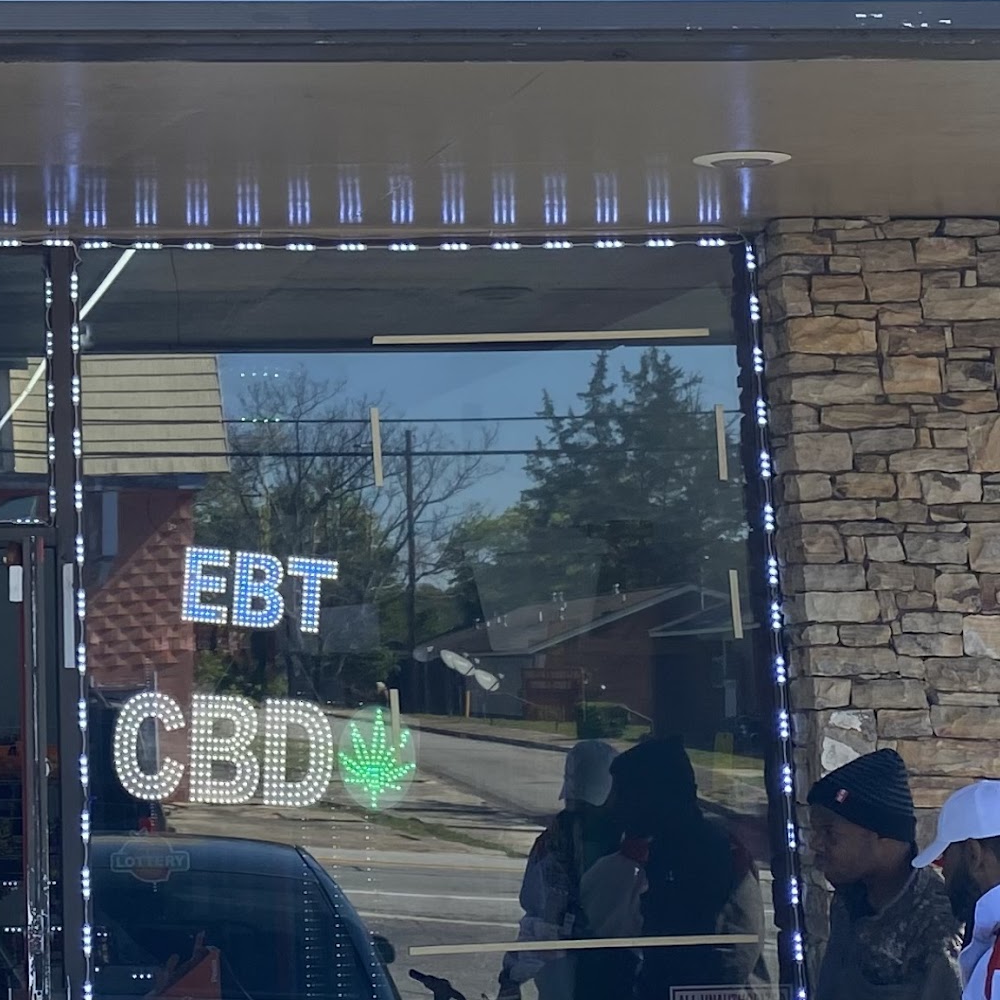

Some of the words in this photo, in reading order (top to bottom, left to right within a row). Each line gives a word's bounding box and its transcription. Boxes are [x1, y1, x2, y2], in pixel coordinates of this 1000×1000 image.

[180, 546, 339, 634] EBT
[112, 691, 334, 808] CBD
[114, 855, 186, 869] LOTTERY
